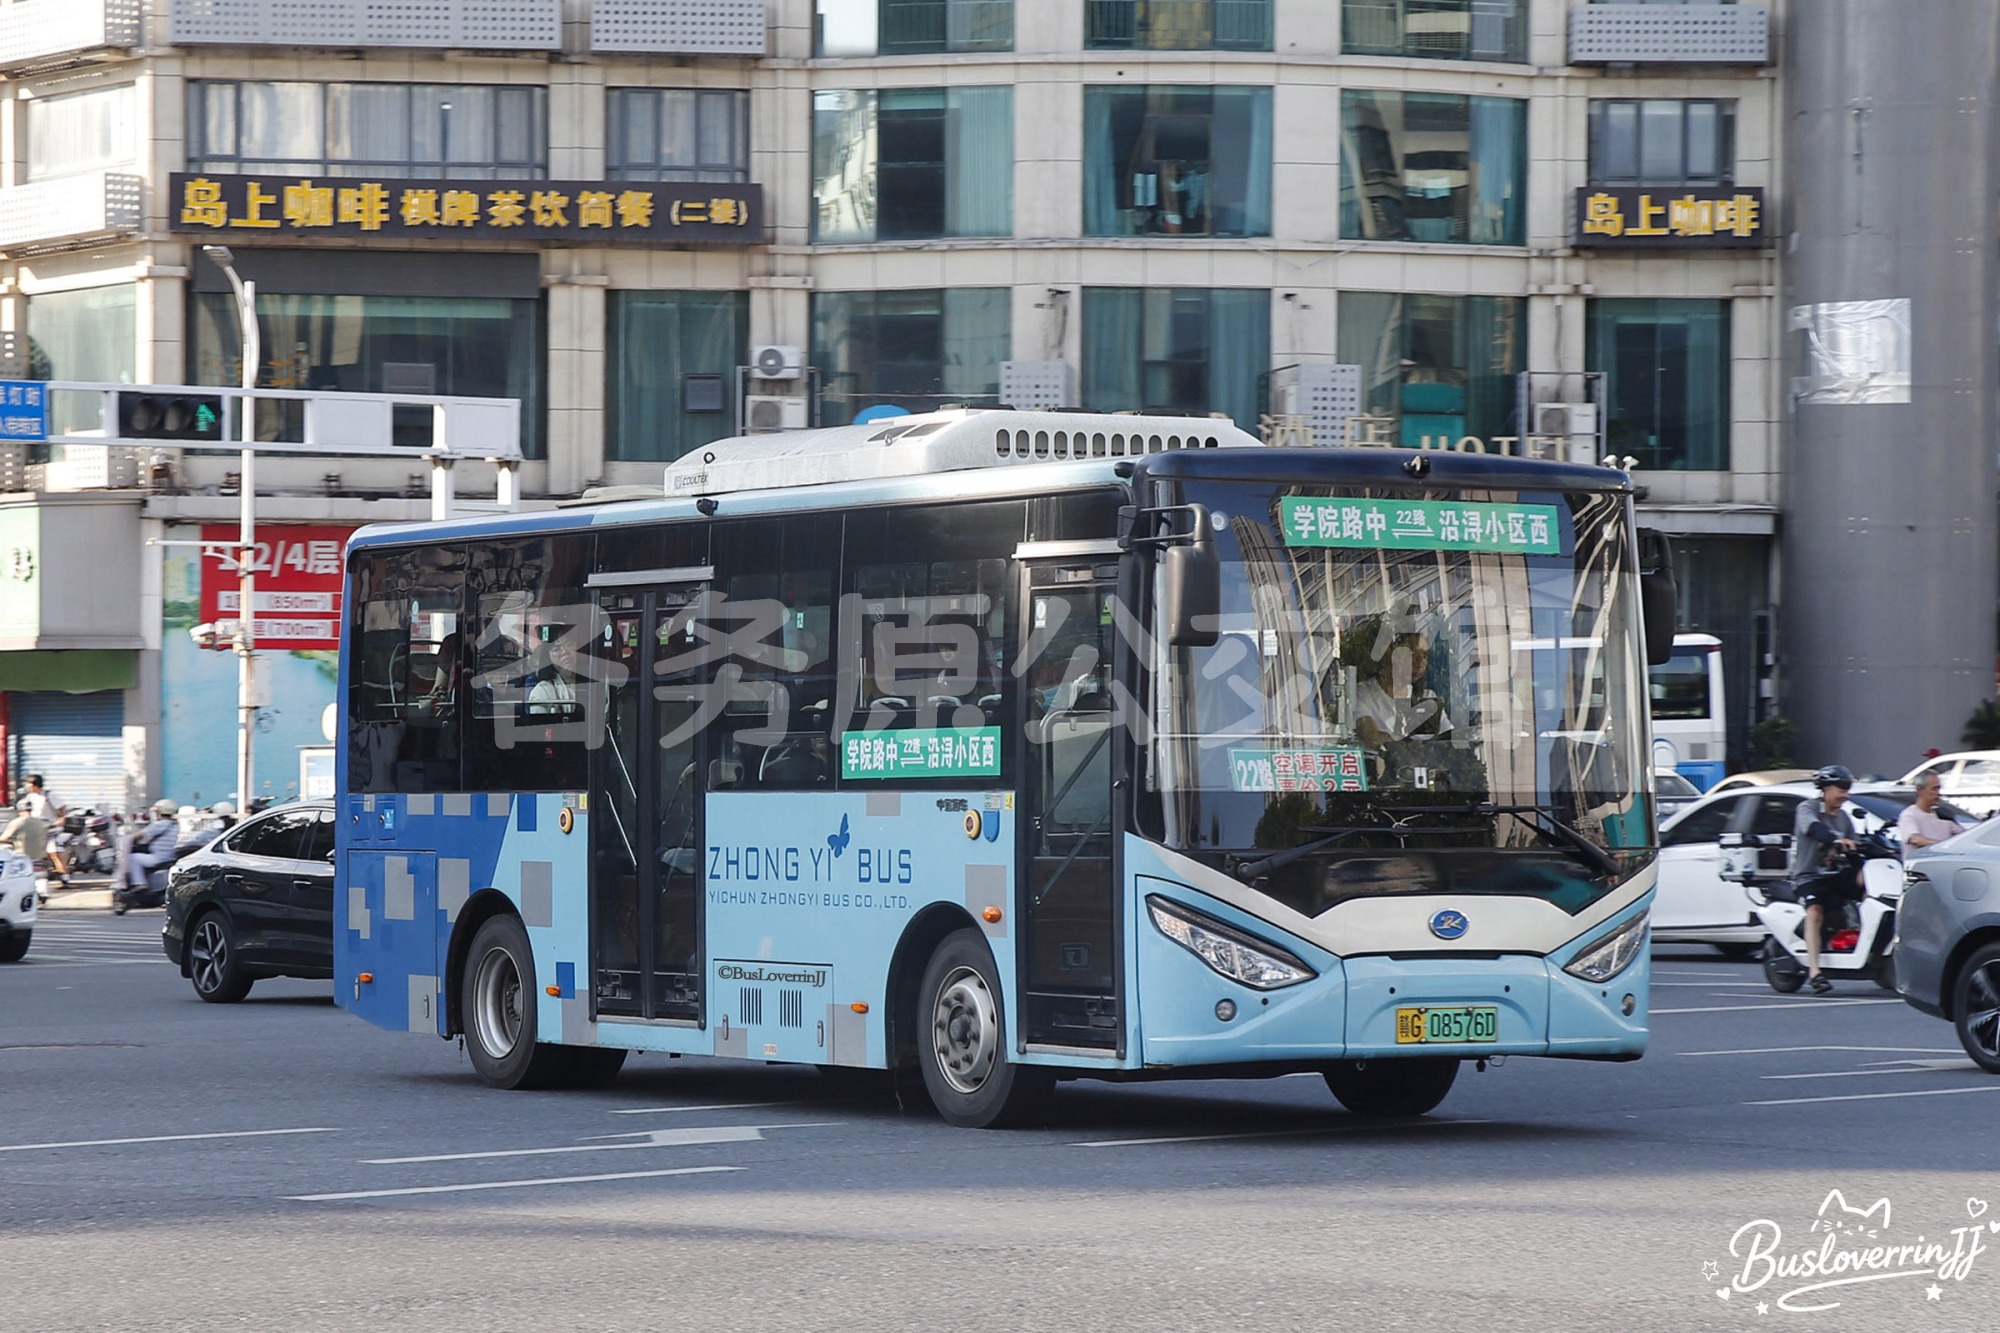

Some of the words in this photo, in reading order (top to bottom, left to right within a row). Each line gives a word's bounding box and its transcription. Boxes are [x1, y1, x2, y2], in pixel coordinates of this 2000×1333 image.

[181, 178, 390, 230] 岛上咖啡
[1583, 192, 1760, 237] 岛上咖啡
[1293, 504, 1387, 541] 学院路中
[1396, 509, 1427, 527] 22路
[1438, 509, 1549, 545] 沿浔小区西
[847, 736, 898, 772] 学院路中
[903, 738, 921, 754] 22路
[927, 735, 996, 769] 沿浔小区西
[1273, 752, 1361, 776] 空调开启
[708, 846, 800, 882] ZHONG
[809, 847, 833, 882] YI
[857, 848, 913, 885] BUS
[708, 890, 757, 905] YICHUN
[760, 892, 820, 907] ZHONGYI
[823, 893, 850, 908] BUS
